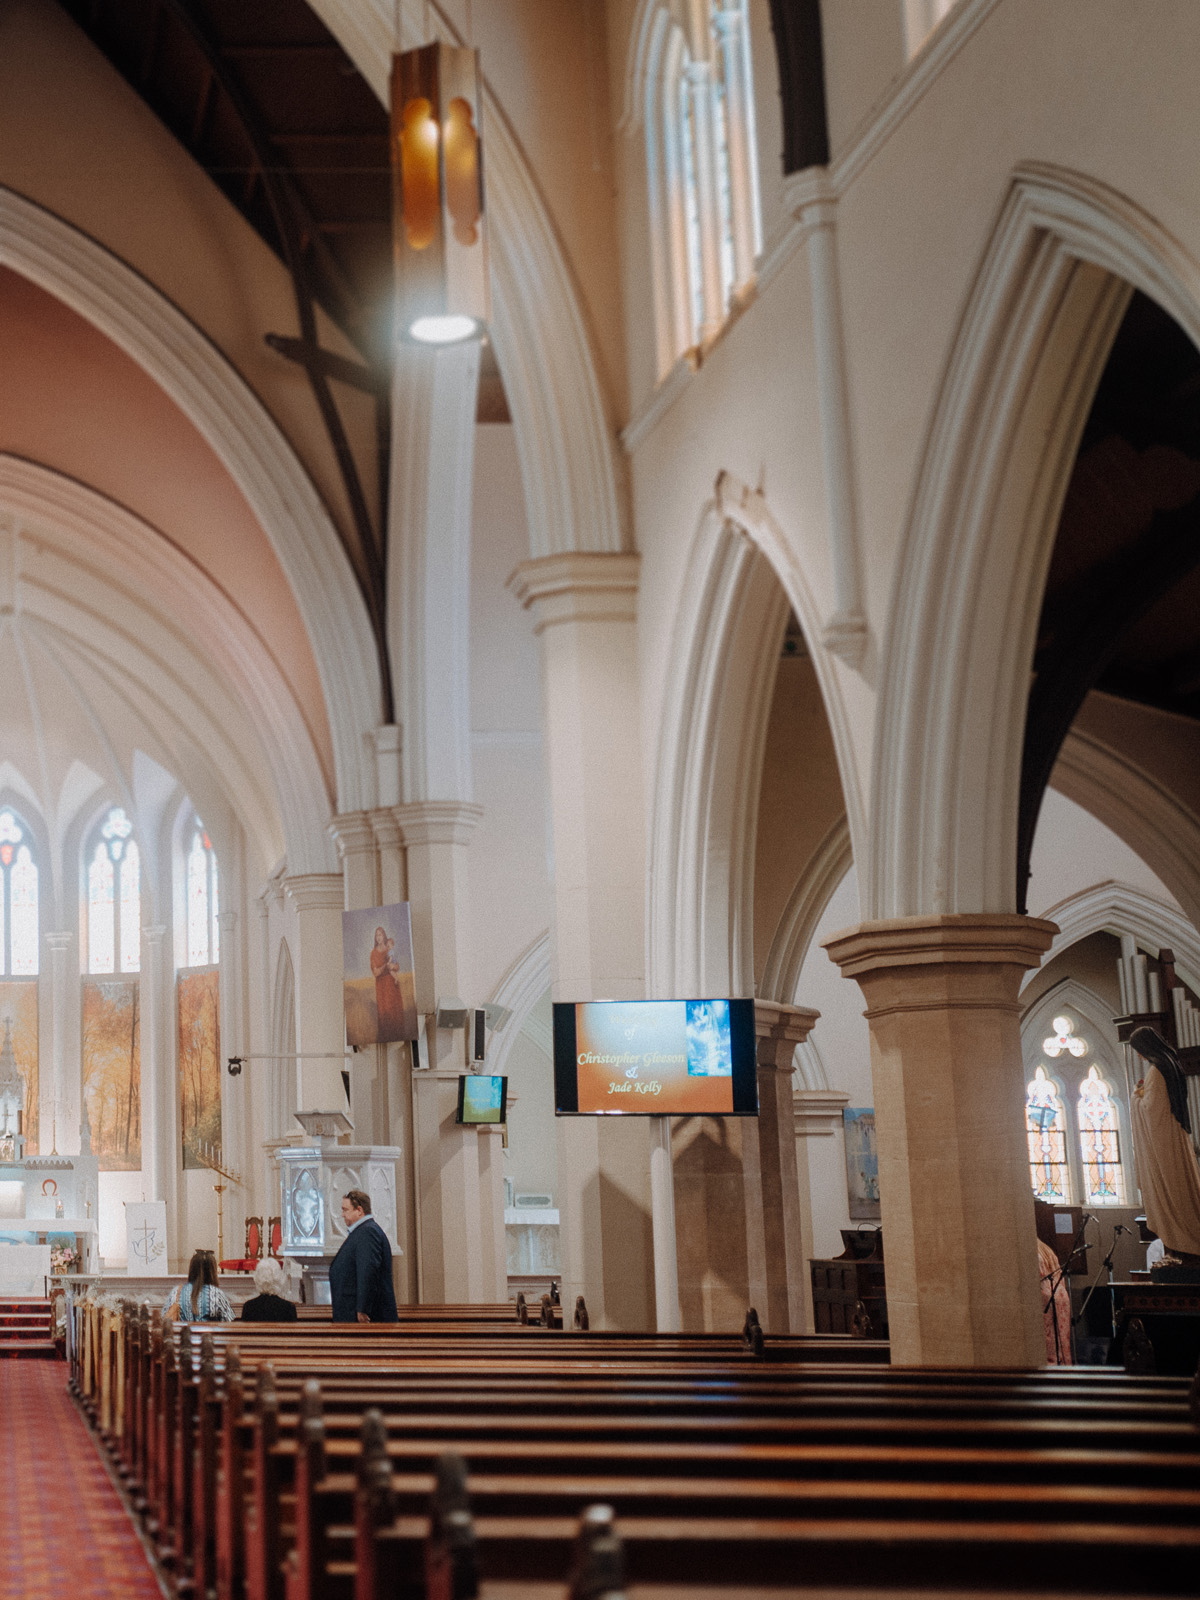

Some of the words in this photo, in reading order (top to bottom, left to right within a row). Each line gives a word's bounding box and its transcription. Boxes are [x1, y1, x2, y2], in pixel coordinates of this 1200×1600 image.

[624, 1025, 640, 1041] of
[577, 1051, 641, 1067] Christopher
[643, 1051, 685, 1067] Gleeson
[625, 1066, 638, 1079] &
[607, 1082, 632, 1095] Jade
[634, 1080, 662, 1096] Kelly
[41, 1178, 58, 1197] Ω
